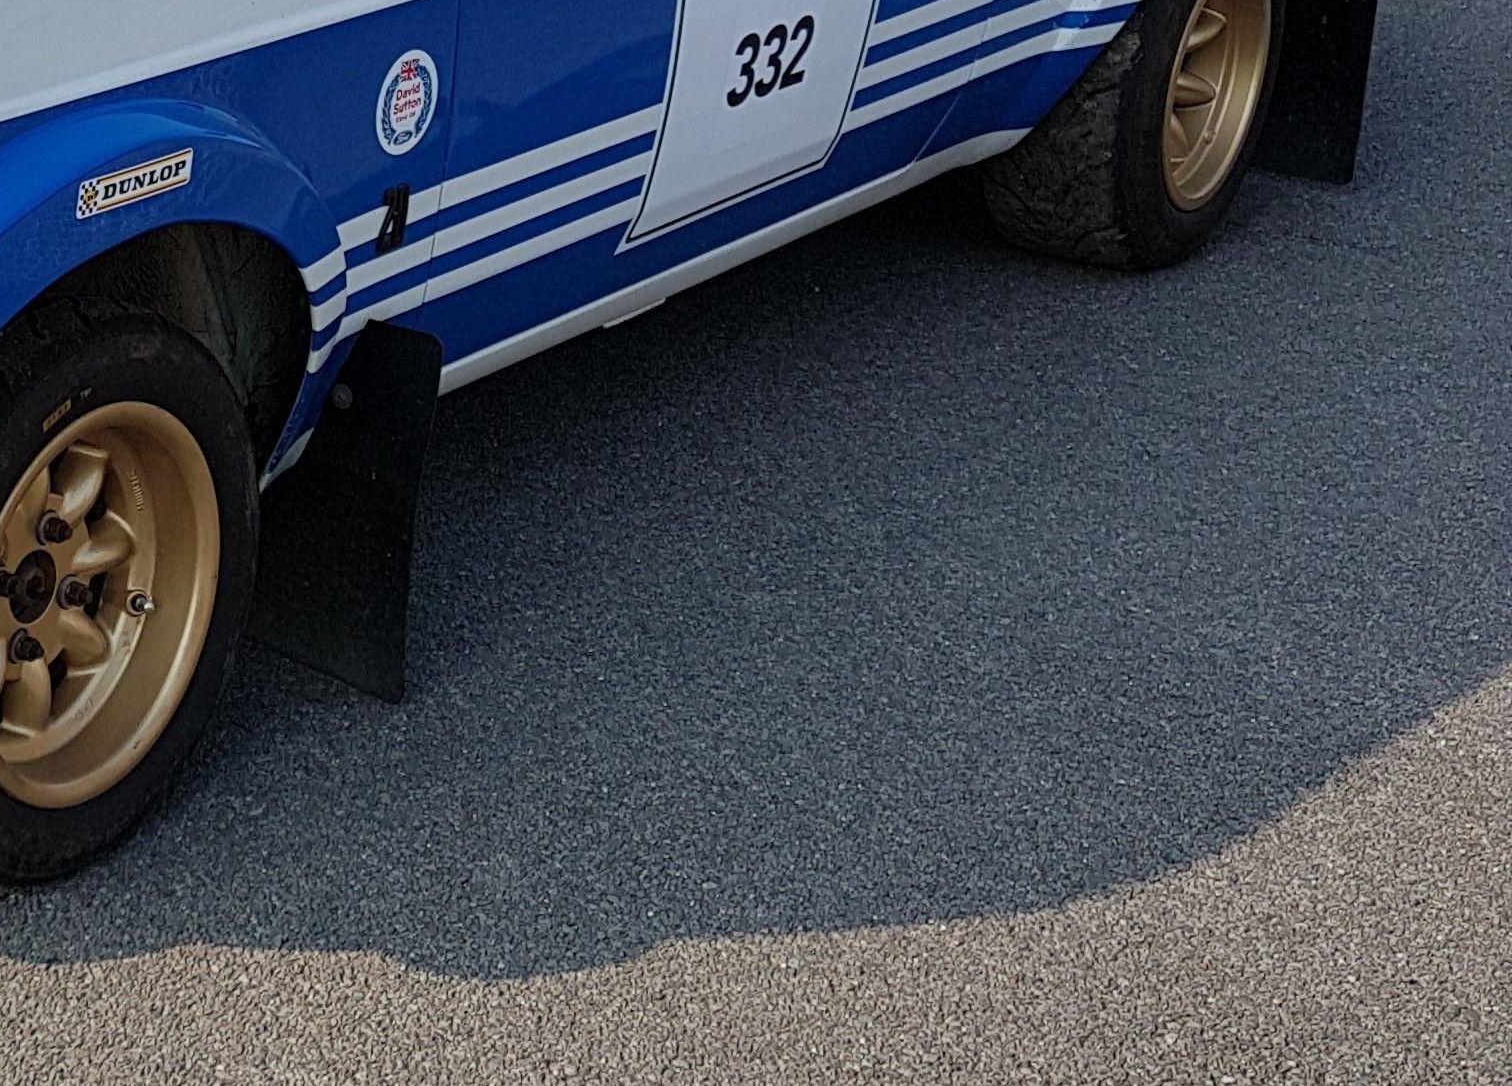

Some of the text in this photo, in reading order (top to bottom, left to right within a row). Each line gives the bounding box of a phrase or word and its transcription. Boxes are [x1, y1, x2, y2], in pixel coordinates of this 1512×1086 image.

[726, 13, 817, 108] 332
[393, 97, 423, 116] Sutton
[395, 81, 422, 102] David
[101, 159, 188, 202] DUNLOP
